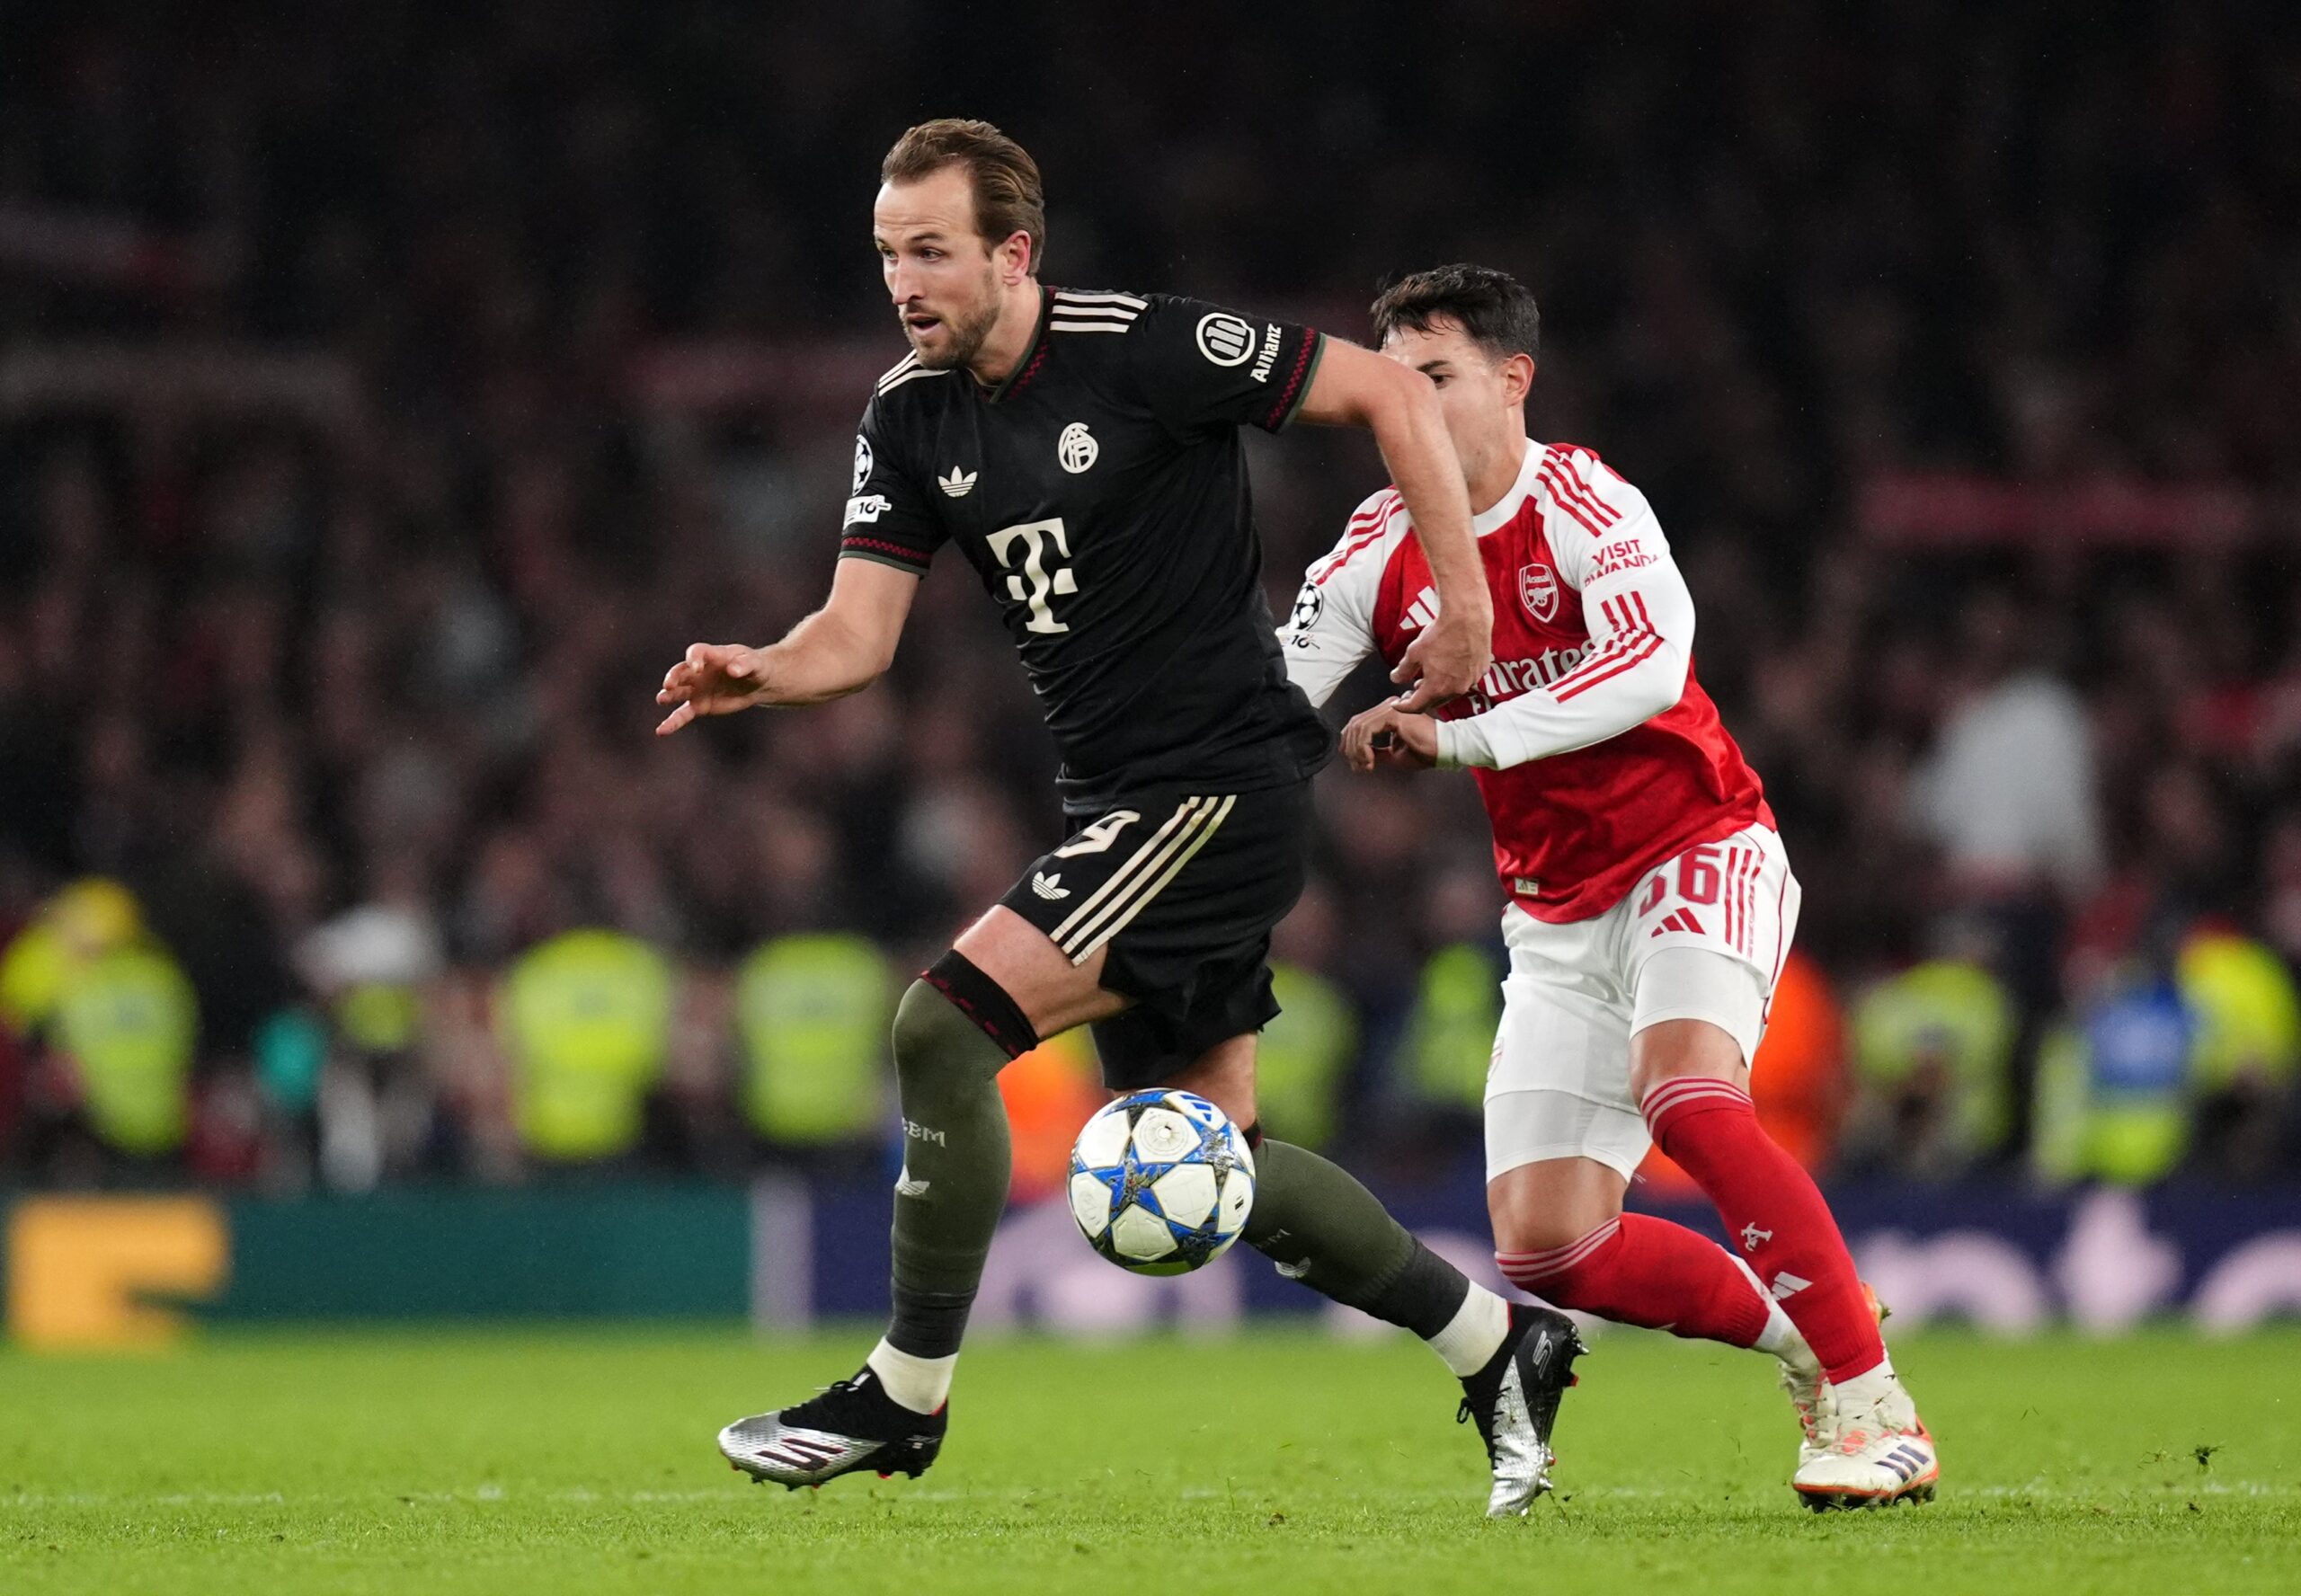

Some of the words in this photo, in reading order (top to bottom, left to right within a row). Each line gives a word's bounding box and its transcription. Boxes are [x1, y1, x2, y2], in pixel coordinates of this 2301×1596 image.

[1250, 324, 1282, 383] Allianz
[986, 518, 1078, 634] T
[1592, 539, 1640, 566] VISIT
[1470, 638, 1595, 697] irates
[1053, 810, 1141, 858] 9
